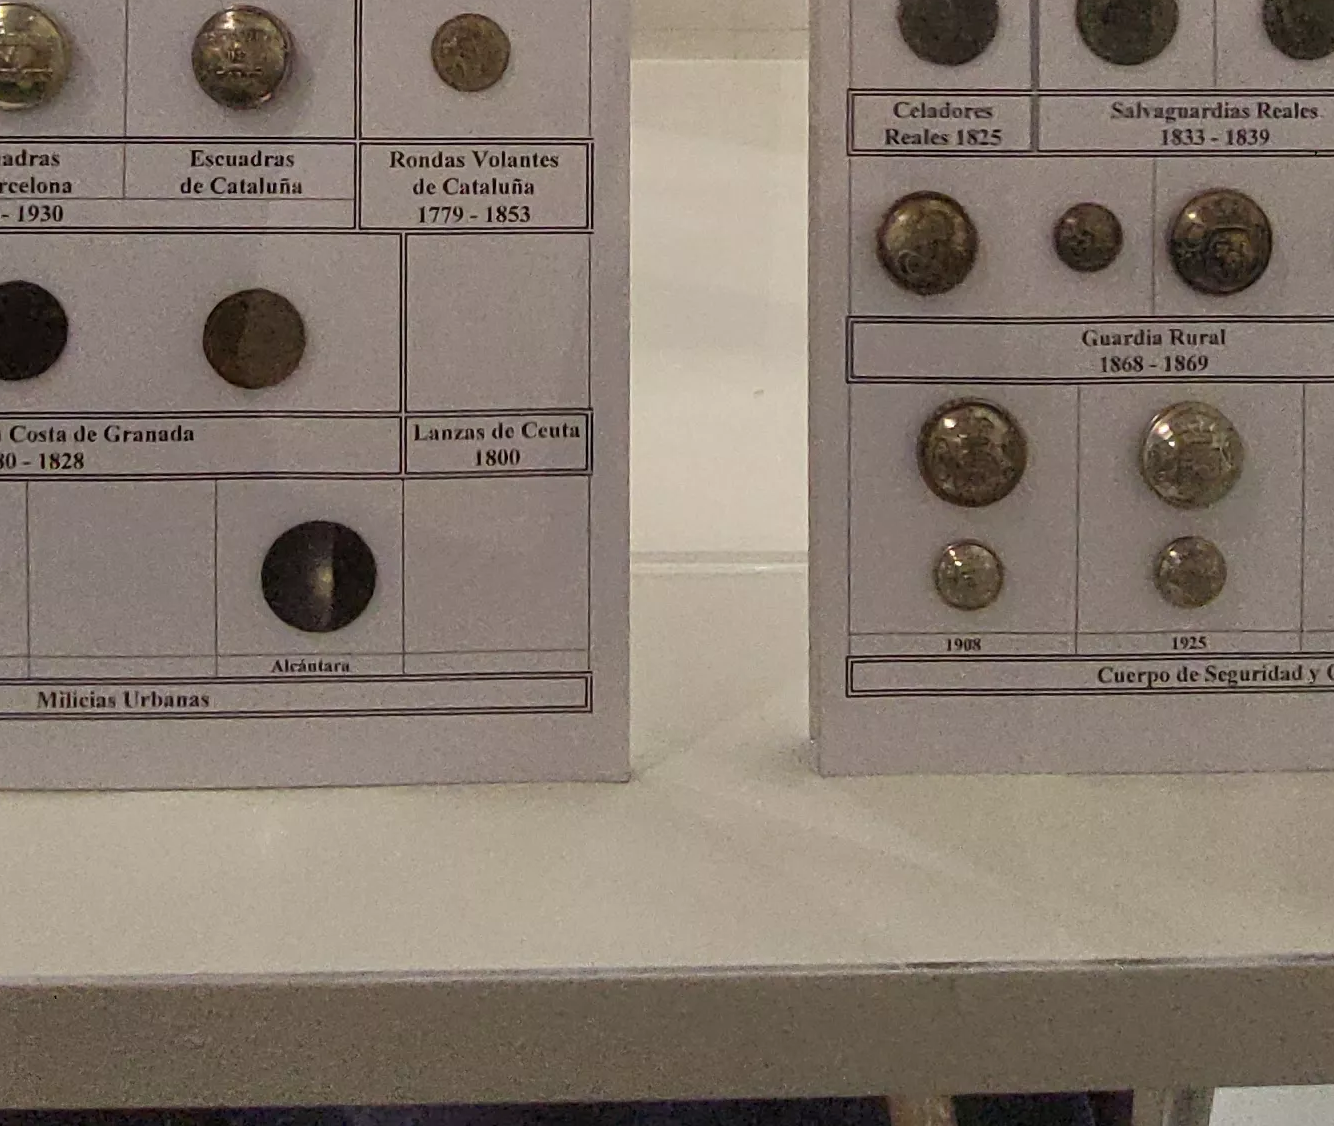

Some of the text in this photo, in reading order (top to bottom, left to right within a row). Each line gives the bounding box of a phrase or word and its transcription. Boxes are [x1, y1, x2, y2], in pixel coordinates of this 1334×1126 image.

[892, 101, 994, 120] Celadores
[1110, 101, 1319, 124] Salvaguardias Reales
[885, 128, 1002, 147] Reales 1825
[1161, 128, 1206, 146] 1833
[1226, 128, 1271, 146] 1839
[190, 149, 295, 168] Escuadras
[389, 150, 559, 169] Rondas Volantes
[179, 176, 303, 196] de Cataluña
[412, 177, 535, 196] de Cataluña
[17, 204, 64, 223] 1930
[419, 206, 464, 224] 1779
[486, 205, 531, 223] 1853
[1081, 328, 1226, 347] Guardia Rural
[1100, 355, 1145, 373] 1868
[1164, 354, 1209, 373] 1869
[8, 425, 67, 444] Costa
[73, 425, 98, 443] de
[103, 424, 195, 443] Granada
[414, 419, 581, 442] Lanzas de Ceuta
[39, 452, 85, 470] 1828
[476, 449, 521, 467] 1800
[946, 637, 982, 652] 1908
[1172, 635, 1207, 651] 1925
[271, 657, 351, 674] Alcántara
[1096, 665, 1171, 688] Cuerpo
[1175, 665, 1200, 683] de
[1204, 663, 1304, 686] Seguridad
[1308, 669, 1322, 683] y
[38, 689, 210, 709] Milicias Urbanas
